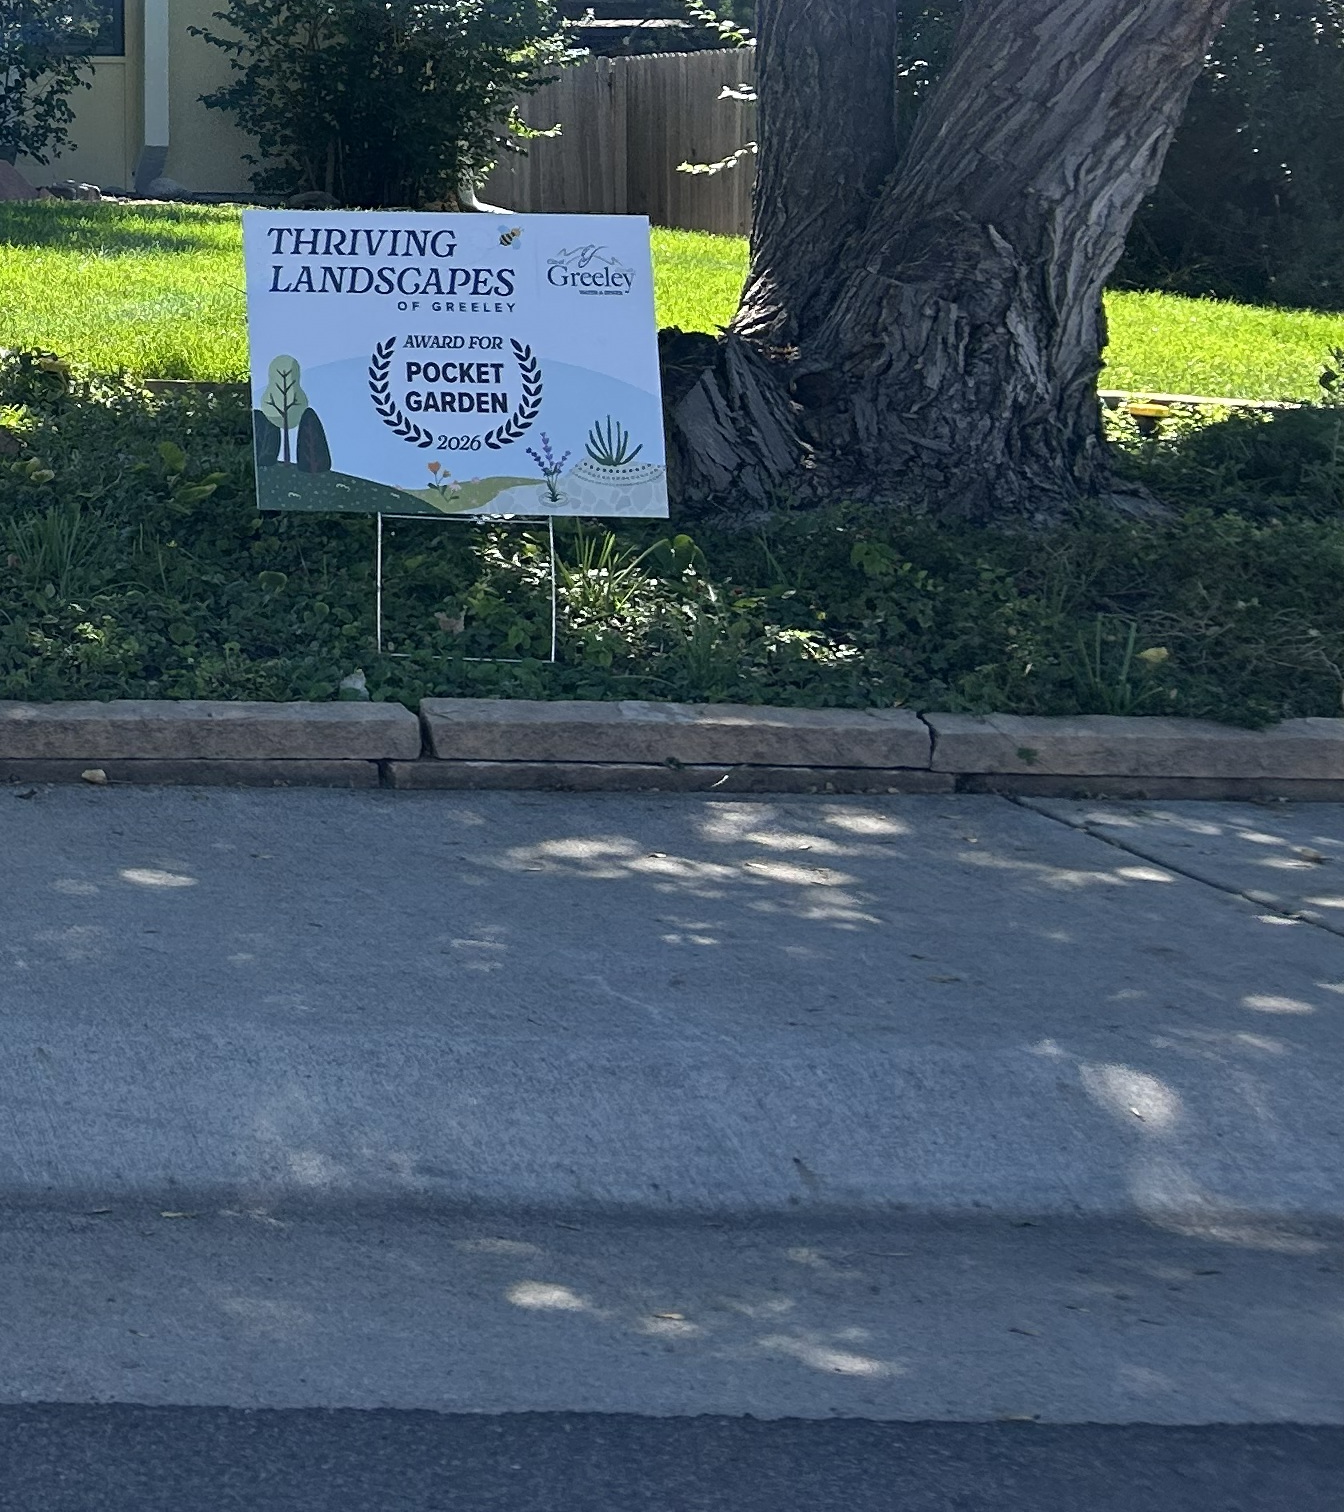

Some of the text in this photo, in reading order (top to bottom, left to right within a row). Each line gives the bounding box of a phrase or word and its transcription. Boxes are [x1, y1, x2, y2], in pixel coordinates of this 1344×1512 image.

[267, 227, 457, 258] THRIVING
[269, 265, 516, 298] LANDSCAPES
[547, 265, 636, 294] Greeley
[397, 301, 516, 313] OF GREELEY
[403, 334, 503, 350] AWARD FOR
[405, 361, 505, 384] POCKET
[405, 390, 509, 414] GARDEN
[436, 434, 482, 451] 2026
